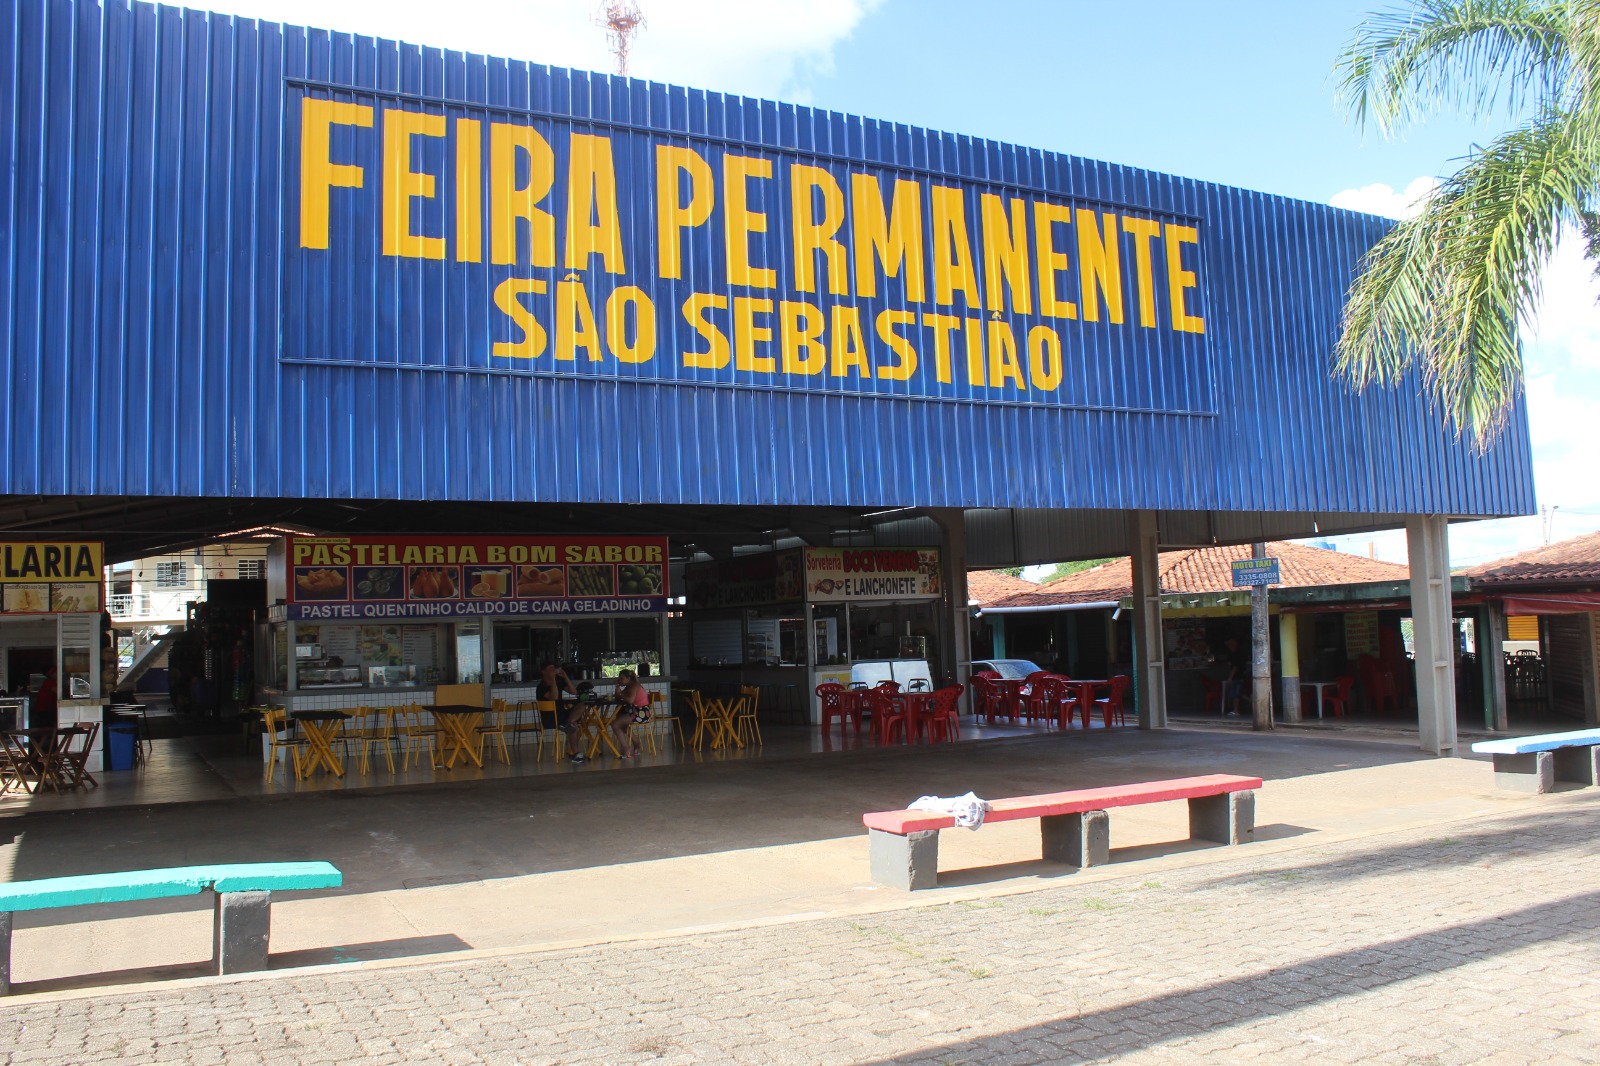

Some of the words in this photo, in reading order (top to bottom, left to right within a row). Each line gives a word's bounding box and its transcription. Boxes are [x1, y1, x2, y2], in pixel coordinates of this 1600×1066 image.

[300, 96, 626, 275] FEIRA
[655, 144, 1205, 334] PERMANENTE
[492, 273, 657, 364] SÃO
[681, 292, 1064, 392] SEBASTIÃO
[0, 544, 96, 578] LARIA
[293, 544, 479, 565] PASTELARIA
[487, 545, 556, 563] BOM
[565, 544, 663, 563] SABOR
[806, 552, 842, 571] Sorveteria
[842, 549, 875, 573] DOCE
[873, 549, 920, 572] VENENO
[1232, 561, 1254, 570] MOTO
[1255, 559, 1272, 568] TAXI
[845, 578, 852, 595] E
[853, 577, 916, 595] LANCHONETE
[1238, 572, 1278, 581] 3335-0808
[724, 583, 776, 604] LANCHONETE
[301, 605, 361, 618] PASTEL
[363, 603, 452, 617] QUENTINHO
[455, 602, 506, 615] CALDO
[509, 601, 528, 613] DE
[532, 600, 571, 613] CANA
[573, 599, 651, 612] GELADINHO
